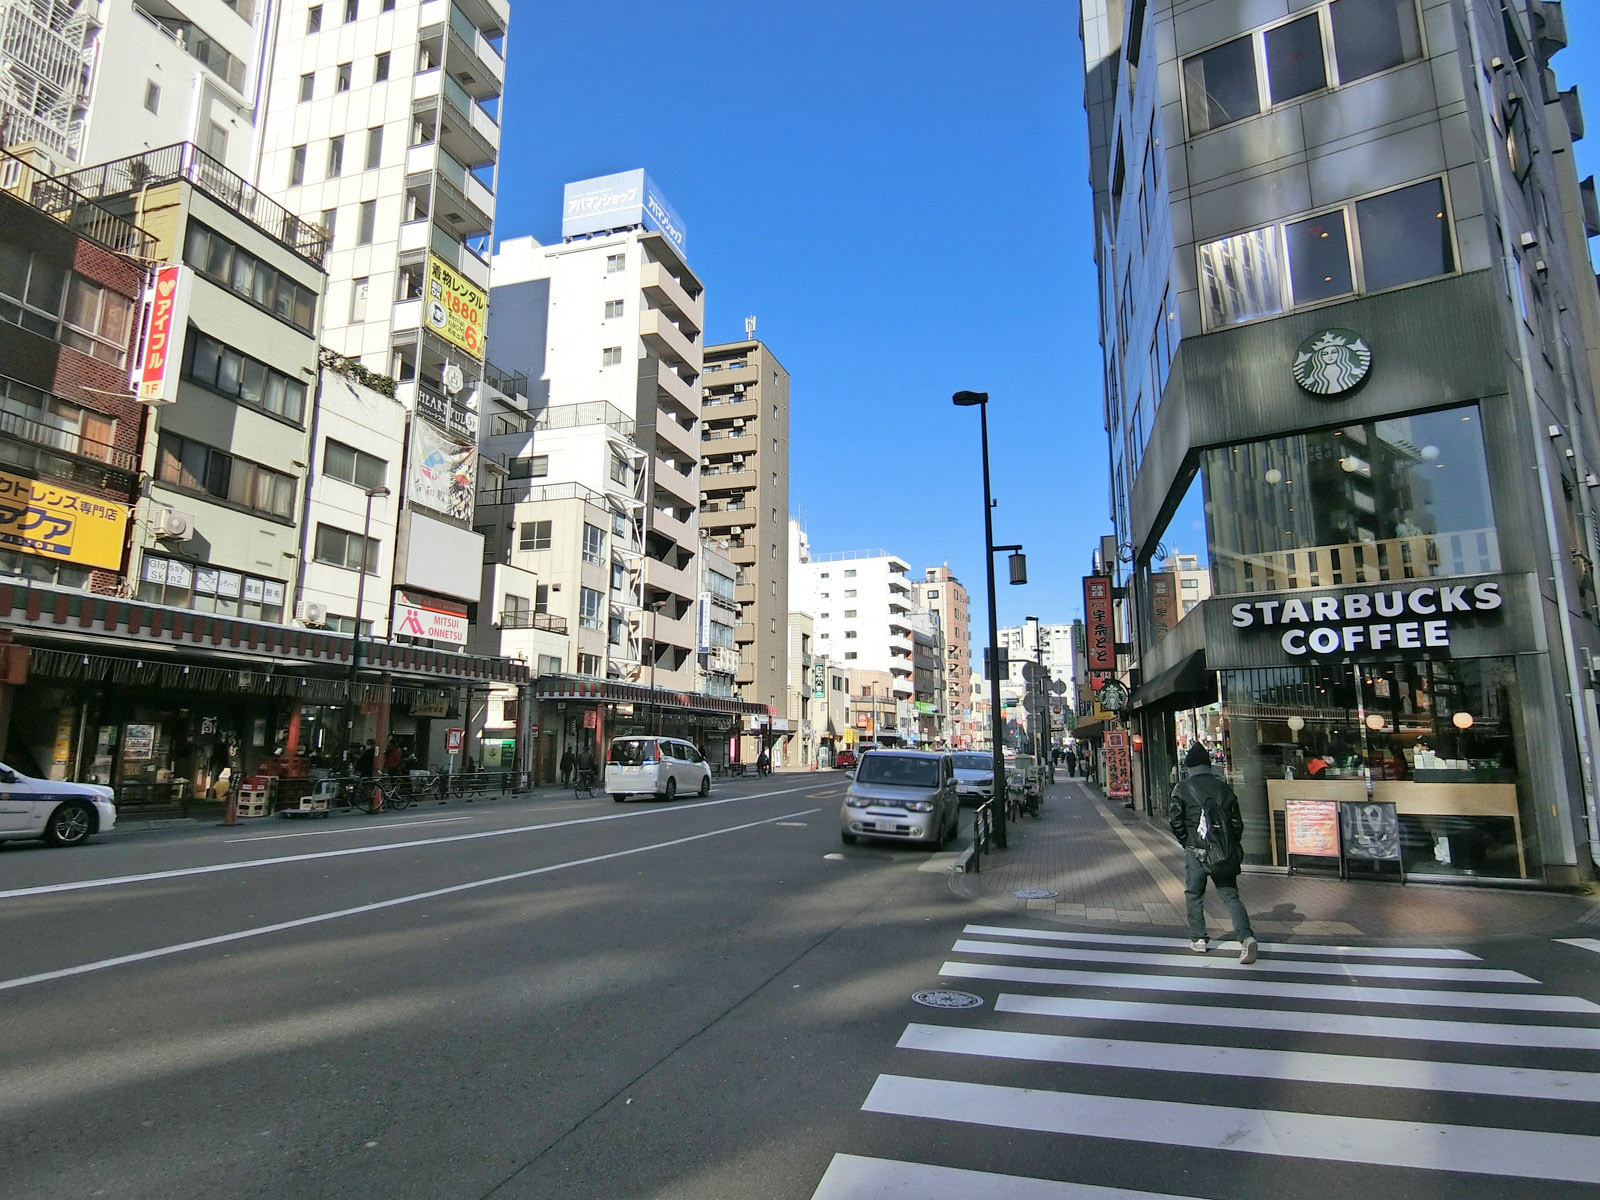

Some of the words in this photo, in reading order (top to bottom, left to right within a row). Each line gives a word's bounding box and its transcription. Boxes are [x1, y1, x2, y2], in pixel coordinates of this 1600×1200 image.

[432, 262, 484, 310] 着物レンタル
[148, 299, 172, 369] アイフル
[145, 383, 159, 395] 1F
[149, 559, 185, 575] Glossy
[151, 570, 183, 584] Skn2
[266, 588, 280, 598] 脱毛
[1231, 583, 1501, 628] STARBUCKS
[433, 616, 459, 628] MITSUI
[428, 627, 462, 641] ONNETSU
[1092, 609, 1107, 662] 宇奈とと
[1281, 619, 1449, 655] COFFEE
